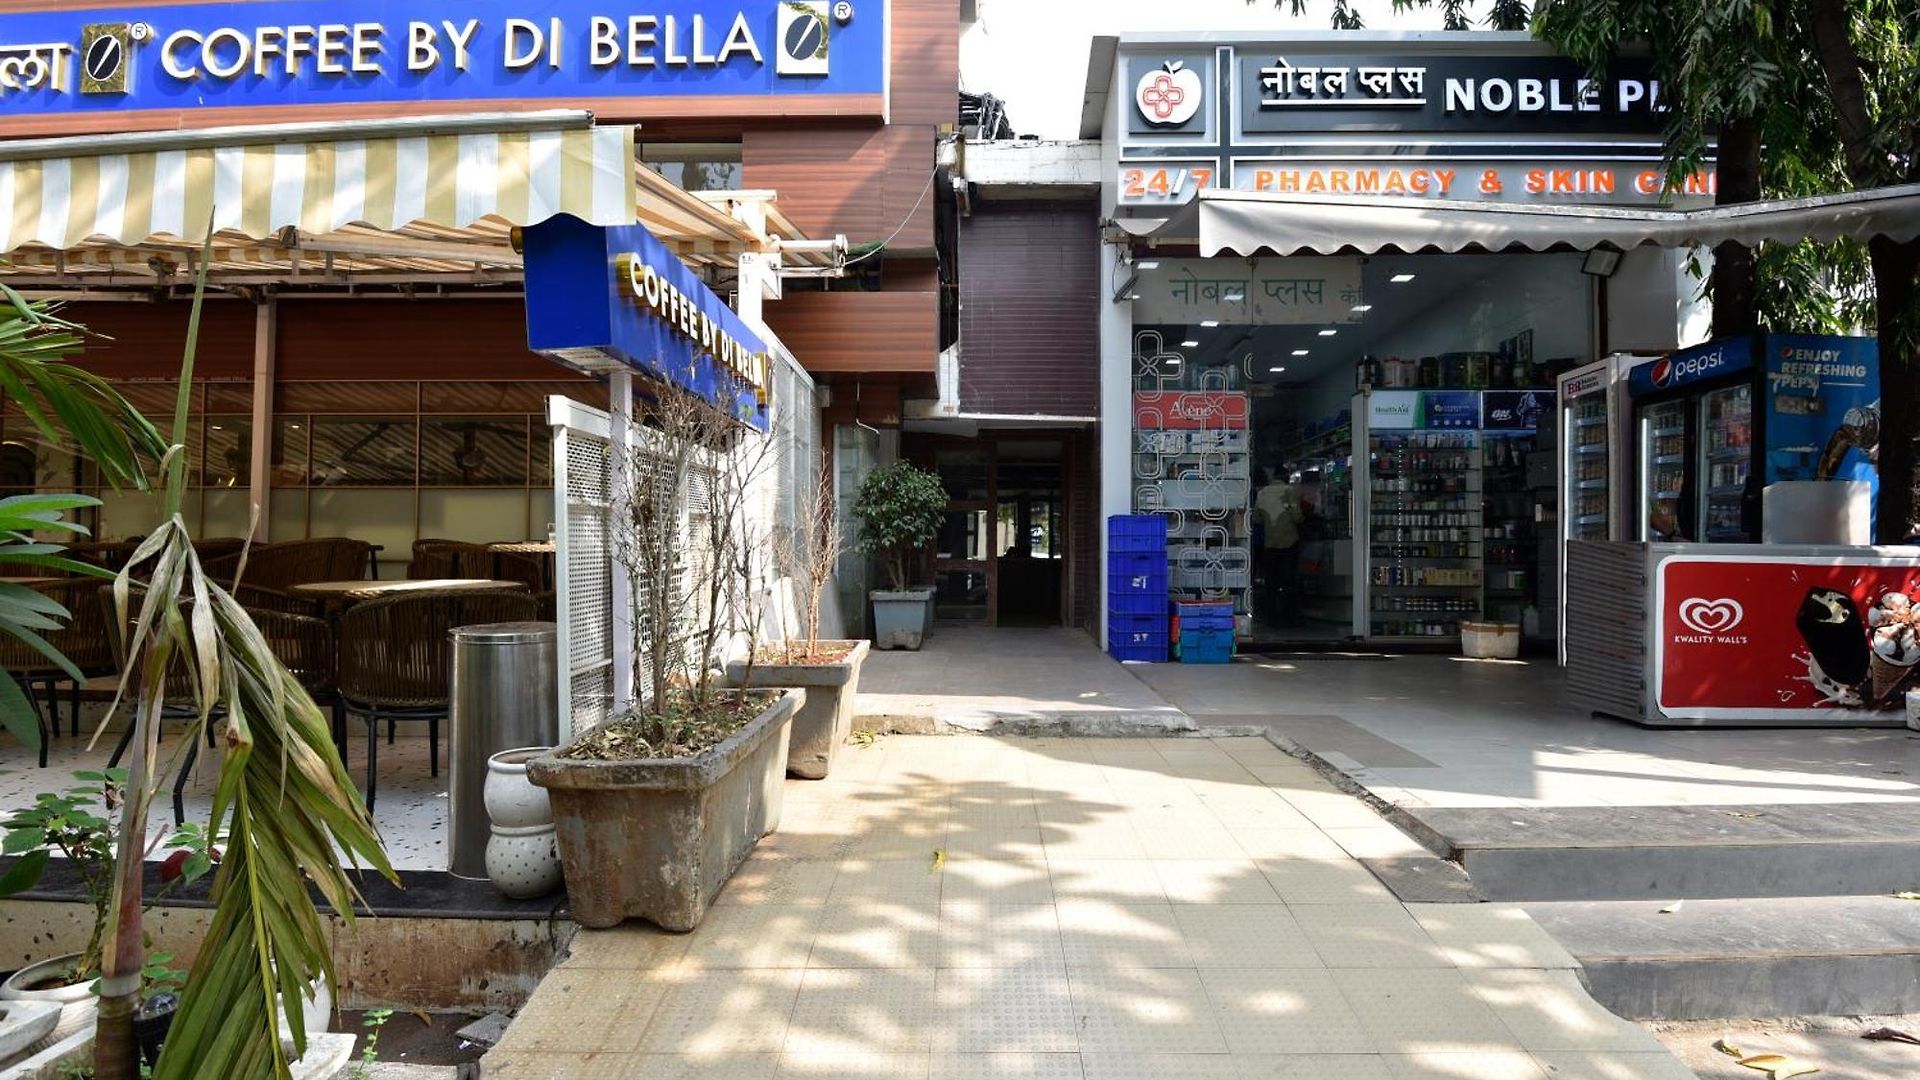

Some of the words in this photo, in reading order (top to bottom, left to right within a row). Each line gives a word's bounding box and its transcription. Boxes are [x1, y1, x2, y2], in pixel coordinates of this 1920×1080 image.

[160, 23, 384, 80] COFFEE
[408, 19, 480, 71] BY
[504, 16, 562, 68] DI
[590, 10, 763, 67] BELLA
[1261, 57, 1349, 95] नोबल
[1358, 67, 1426, 95] प्लस
[1445, 78, 1601, 112] NOBLE
[1124, 169, 1213, 197] 24/7
[1255, 168, 1455, 195] PHARMACY
[1479, 169, 1503, 194] &
[1526, 169, 1616, 195] SKIN
[1169, 267, 1249, 304] नोबल
[1261, 278, 1327, 305] प्लस
[625, 251, 699, 340] COFFEE
[702, 311, 718, 356] BY
[721, 328, 734, 368] DI
[1675, 347, 1723, 381] pepsi
[1781, 362, 1867, 378] REFRESHING
[1795, 349, 1841, 362] ENJOY
[1674, 635, 1714, 643] KWALITY
[1717, 636, 1748, 644] WALL'S
